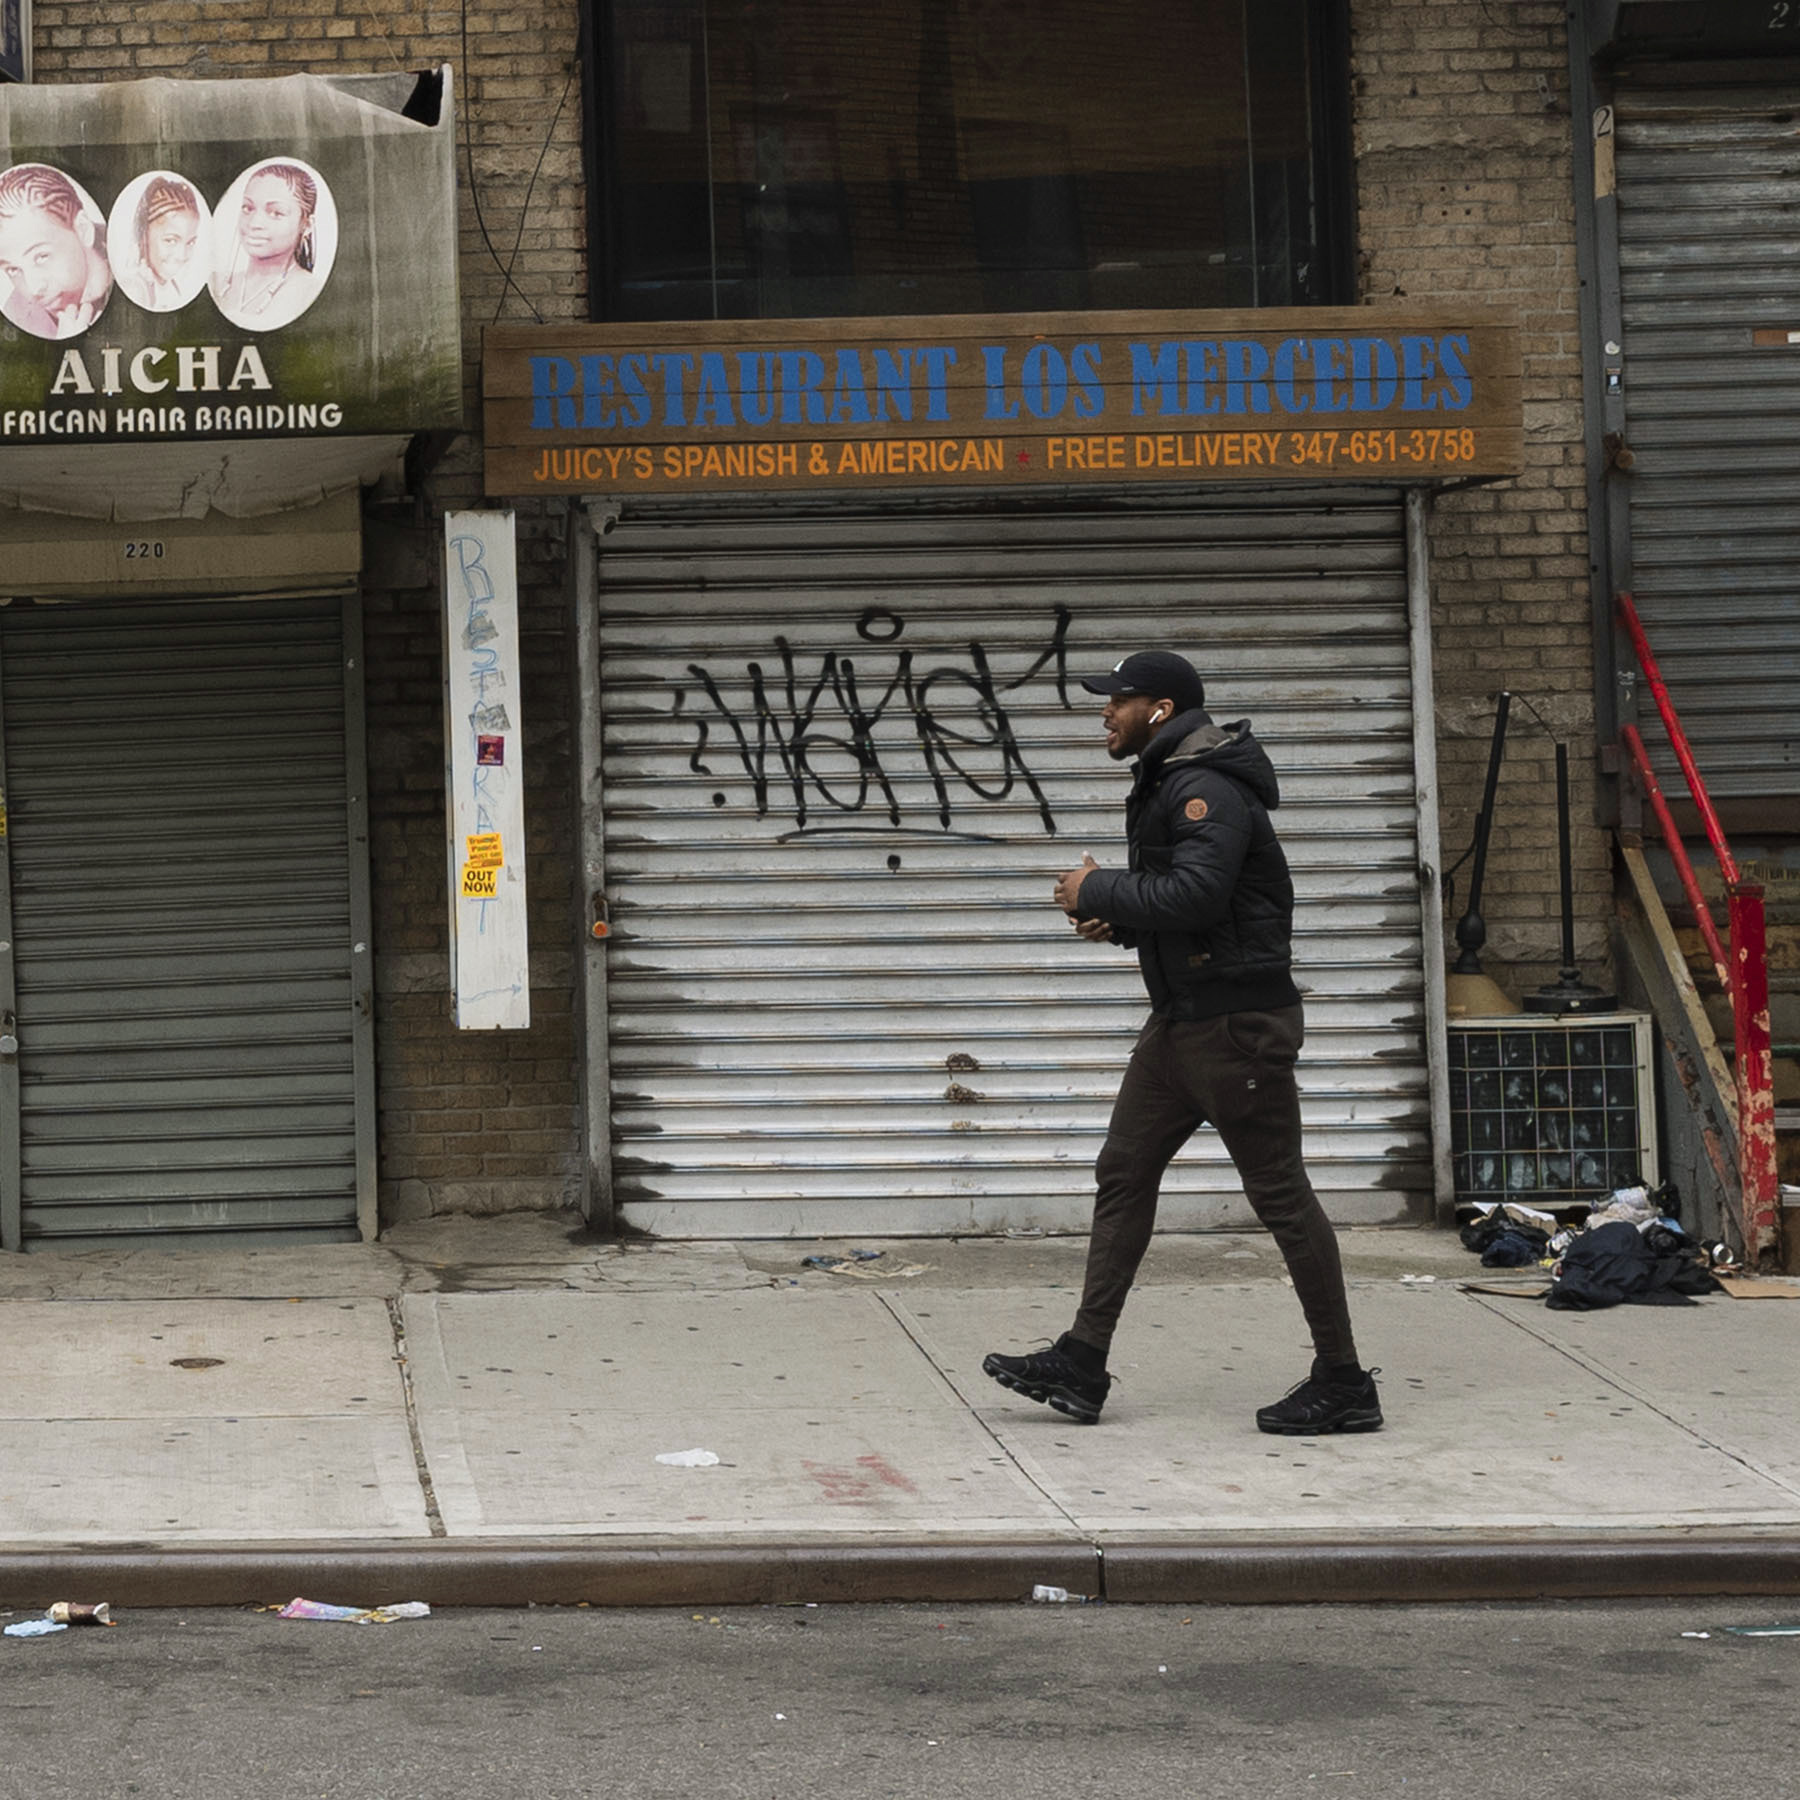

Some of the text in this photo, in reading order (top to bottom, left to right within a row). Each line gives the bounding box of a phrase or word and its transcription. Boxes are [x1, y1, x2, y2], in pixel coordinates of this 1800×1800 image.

[51, 344, 273, 396] AICHA
[529, 333, 1473, 430] RESTAURANT LOS MERCEDES
[115, 406, 188, 434] HAIR
[195, 402, 344, 432] BRAIDING
[533, 427, 1476, 481] JUICY'S SPANISH & AMERICAN FREE DELIVERY 347-651-3758
[125, 542, 165, 560] 220
[463, 880, 496, 893] NOW
[466, 870, 494, 882] OUT
